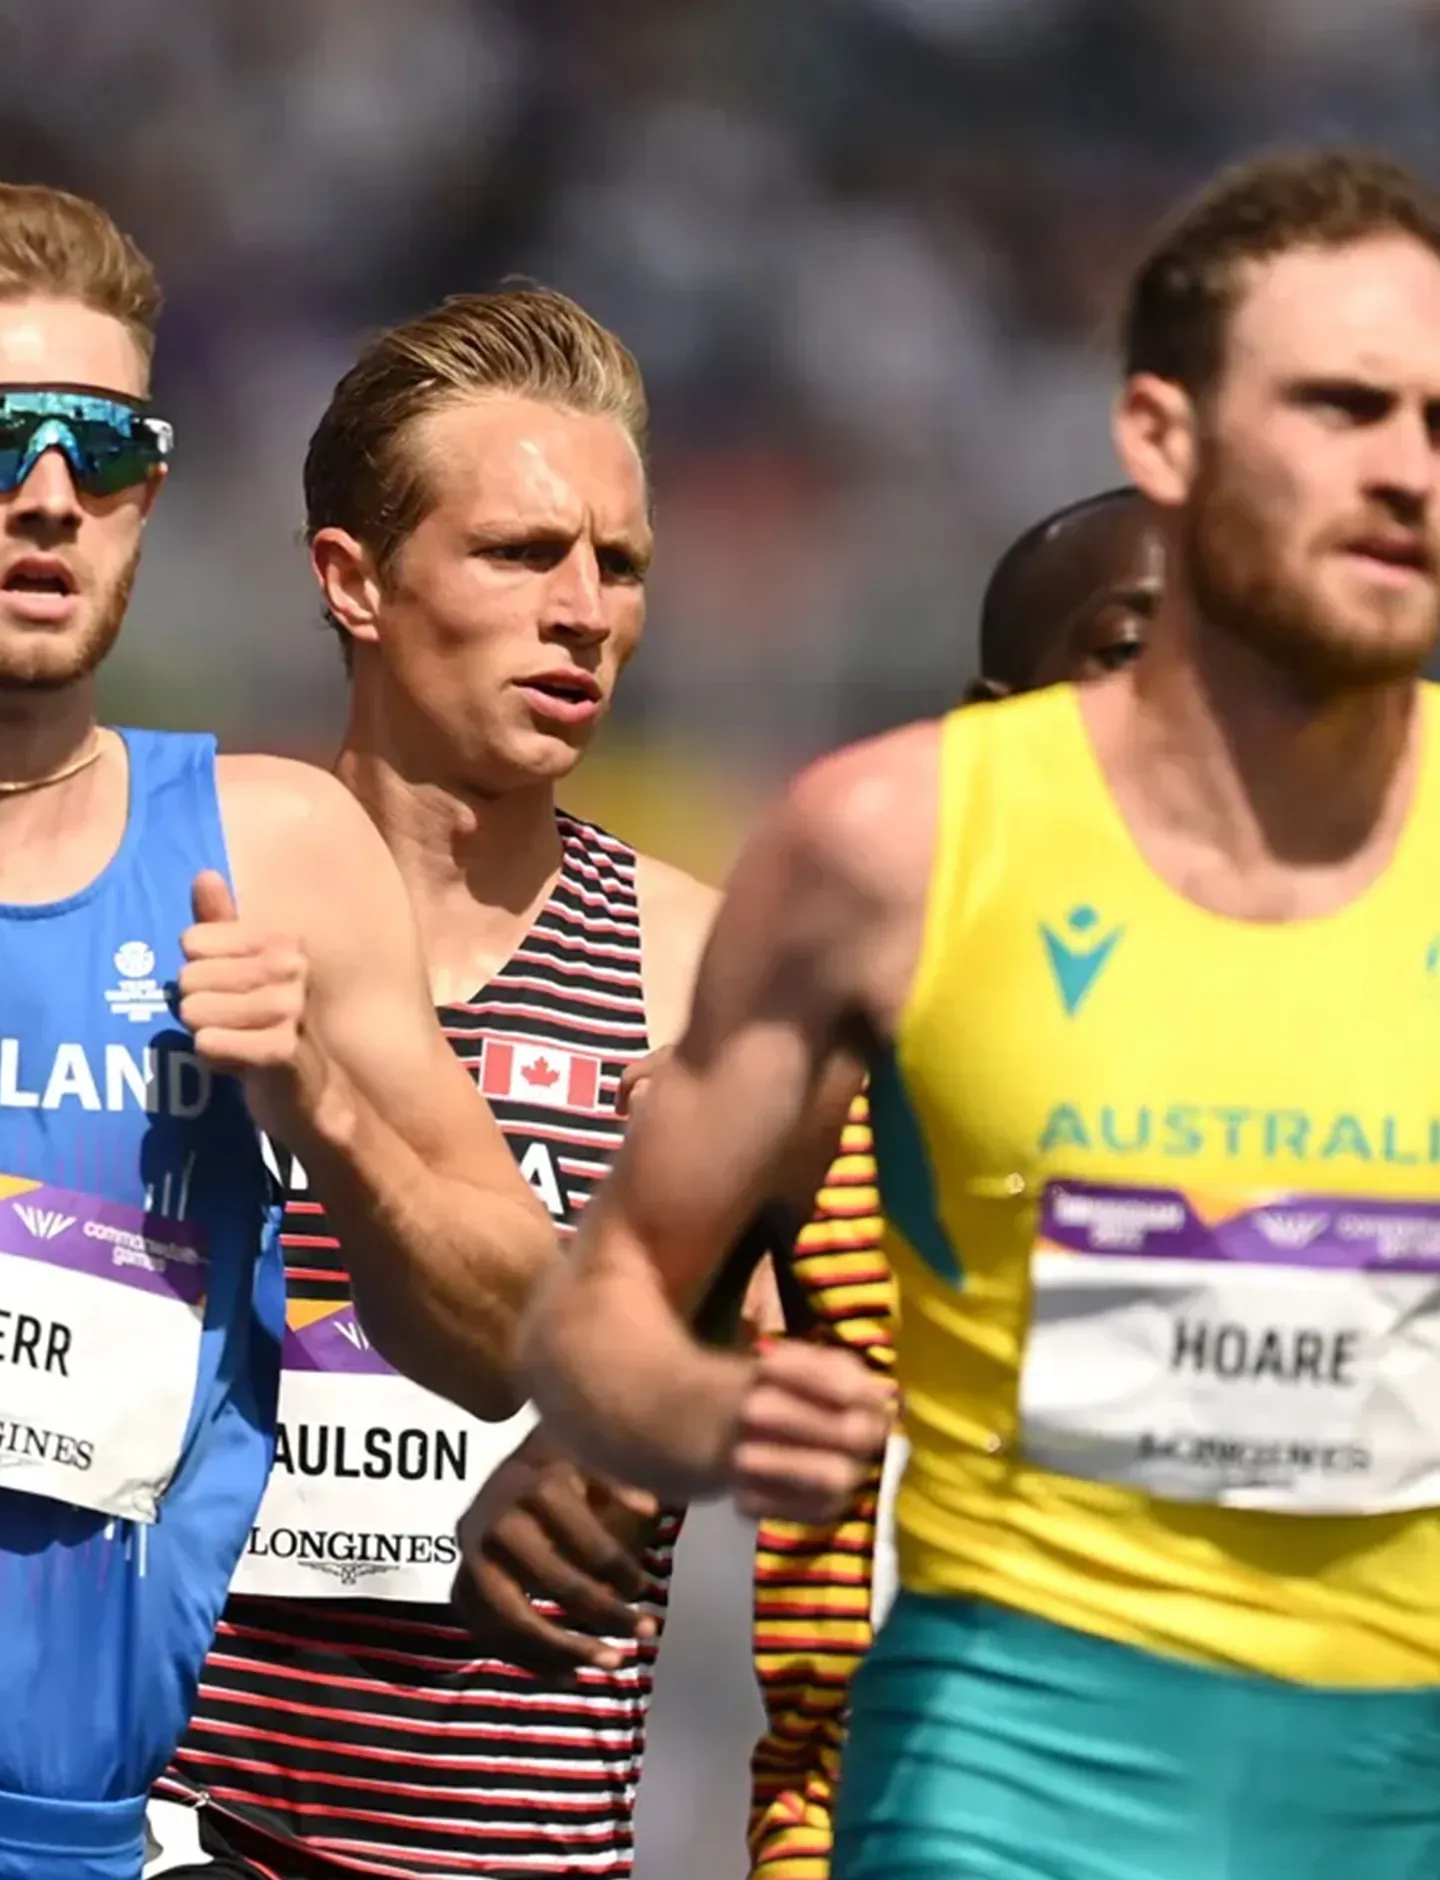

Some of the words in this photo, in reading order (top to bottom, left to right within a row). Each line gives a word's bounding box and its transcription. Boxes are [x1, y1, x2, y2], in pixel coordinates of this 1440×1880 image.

[1036, 1101, 1440, 1165] AUSTRALI
[1170, 1316, 1360, 1386] HOARE
[274, 1422, 468, 1481] AULSON
[248, 1527, 458, 1565] LONGINES
